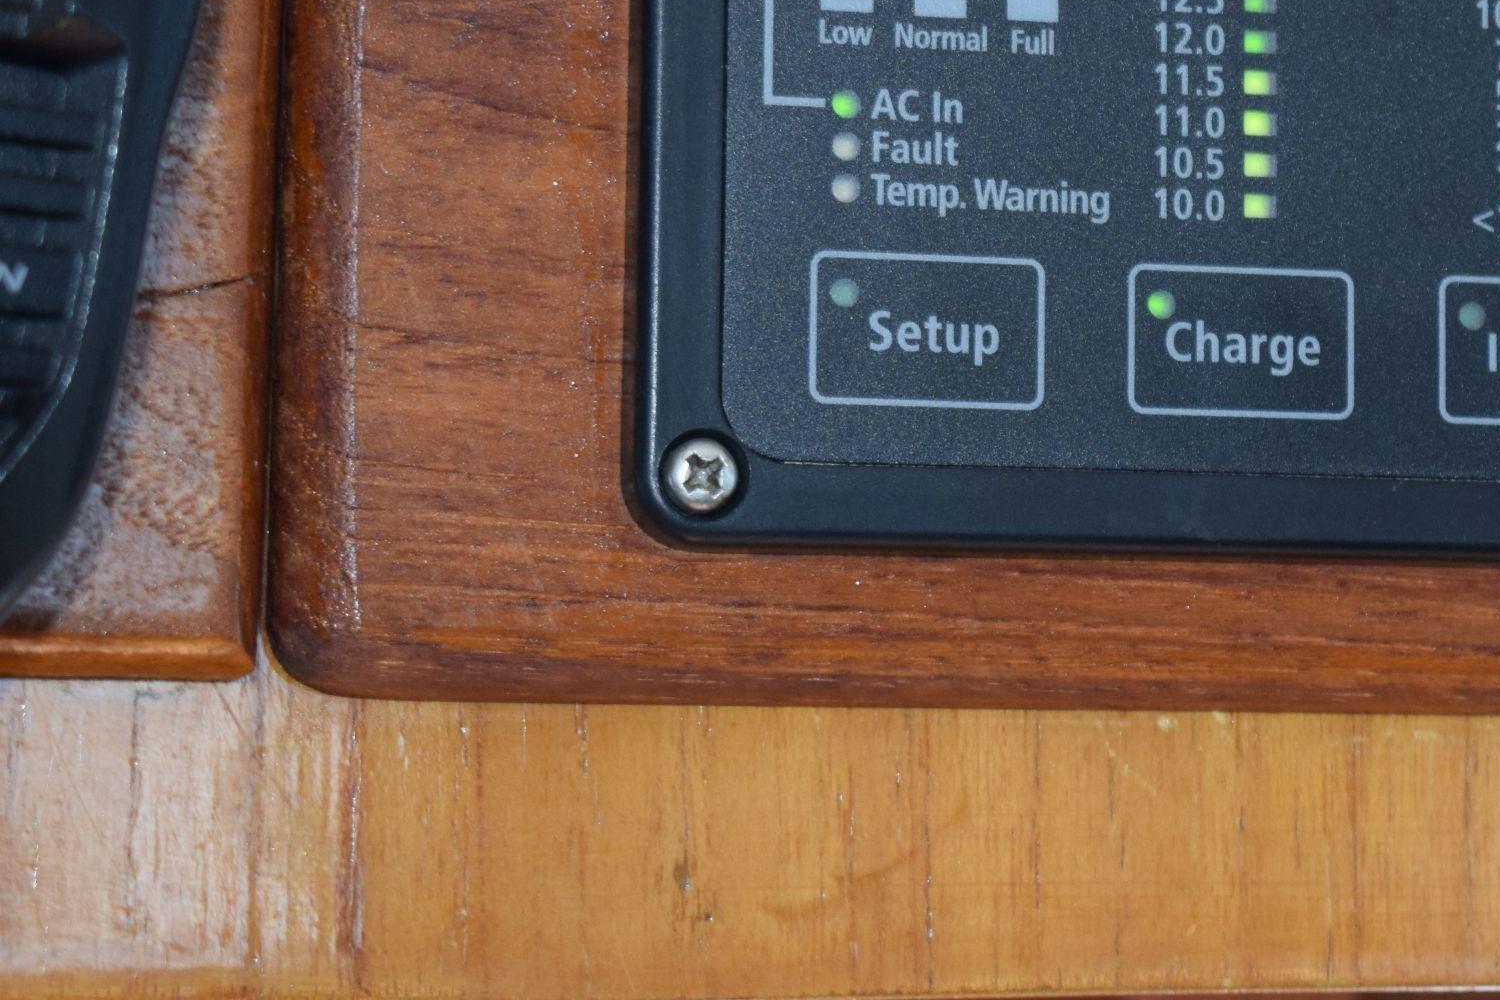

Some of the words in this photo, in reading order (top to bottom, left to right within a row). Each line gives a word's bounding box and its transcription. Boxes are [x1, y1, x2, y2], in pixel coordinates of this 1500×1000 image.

[819, 18, 872, 45] Low
[894, 22, 987, 51] Normal
[1011, 29, 1054, 55] Full
[1155, 21, 1225, 55] 12.0
[1155, 62, 1224, 96] 11.5
[871, 88, 919, 121] AC
[932, 91, 963, 123] In
[1155, 104, 1225, 138] 11.0
[871, 130, 958, 166] Fault
[1155, 146, 1224, 180] 10.5
[870, 173, 966, 217] Temp.
[974, 178, 1110, 224] Warning
[1155, 188, 1224, 221] 10.0
[869, 310, 999, 365] Setup
[1165, 320, 1320, 376] Charge
